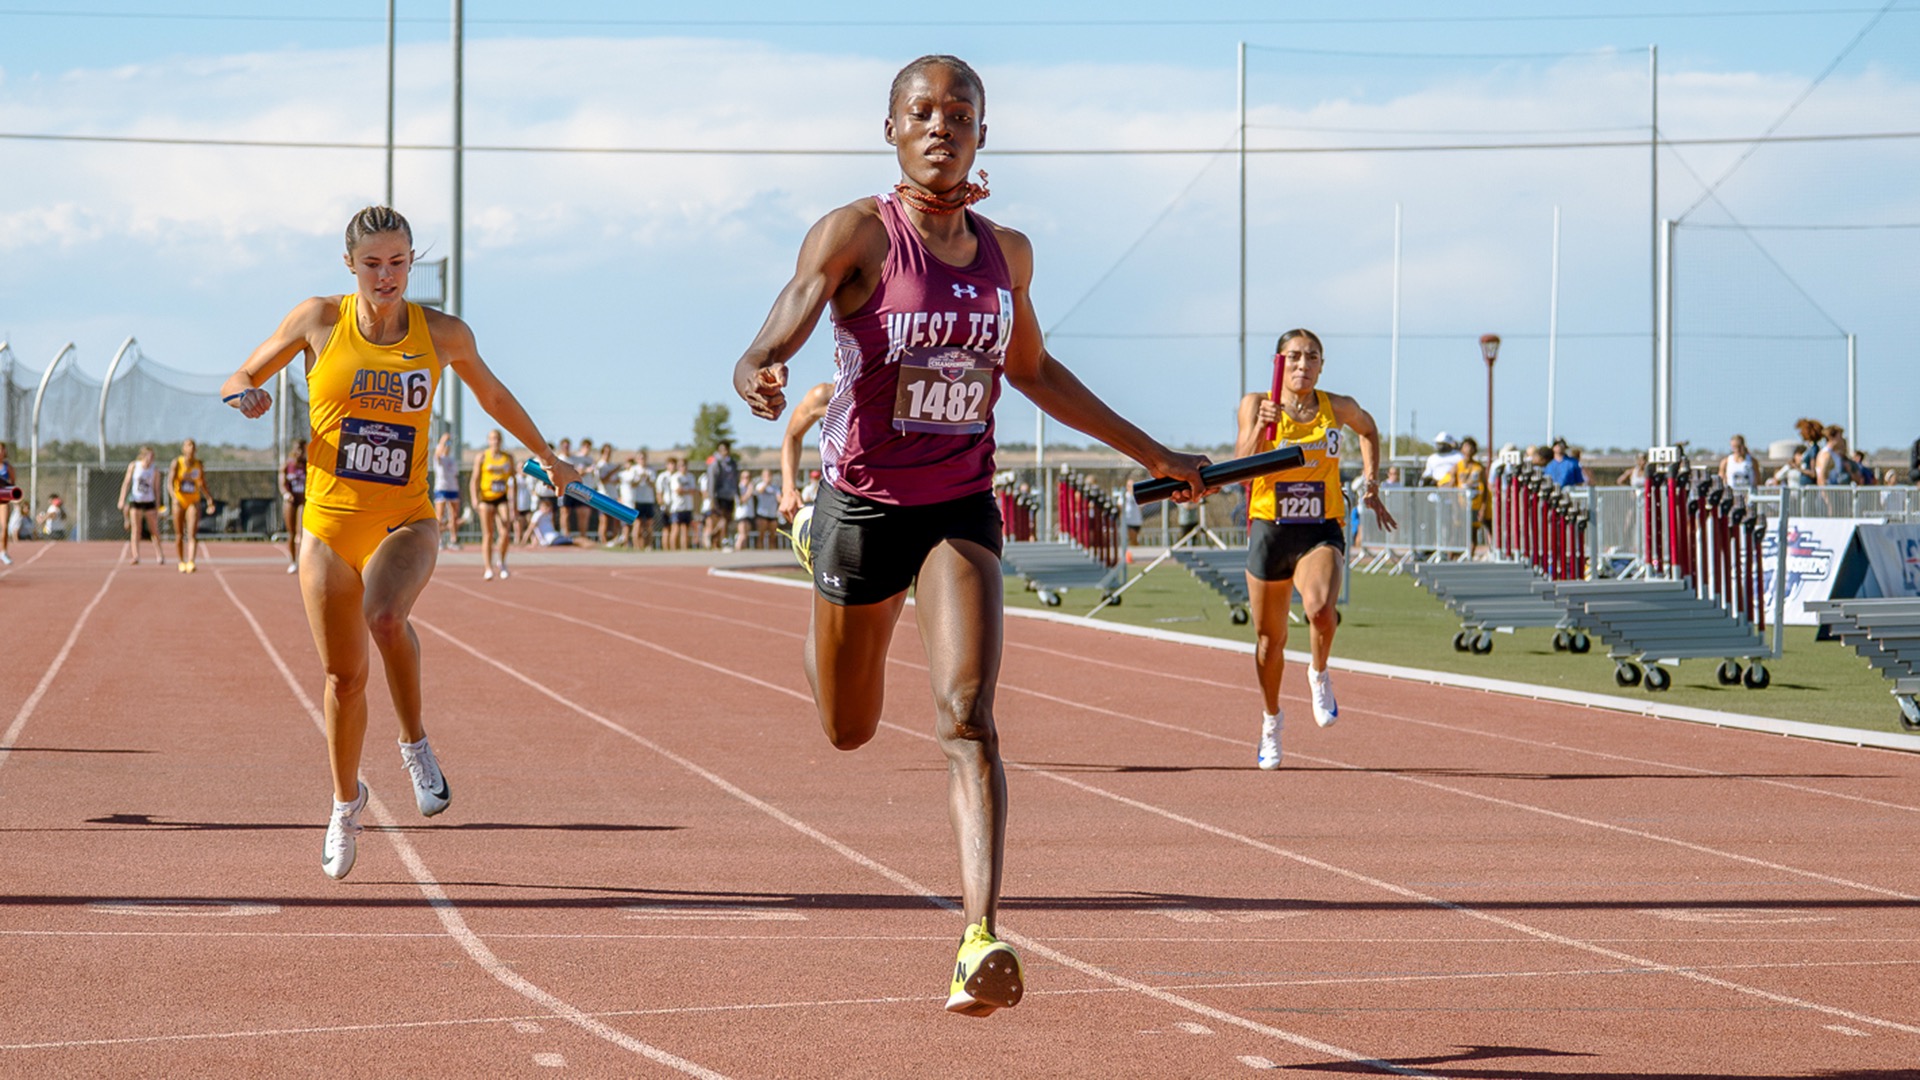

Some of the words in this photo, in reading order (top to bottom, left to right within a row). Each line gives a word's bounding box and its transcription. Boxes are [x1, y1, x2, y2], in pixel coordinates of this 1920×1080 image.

[885, 312, 957, 364] WEST
[360, 397, 403, 413] STATE
[407, 373, 427, 409] 6
[907, 380, 984, 421] 1482
[1328, 430, 1339, 455] 3
[344, 442, 407, 477] 1038
[1279, 497, 1321, 517] 1220
[956, 961, 967, 983] N
